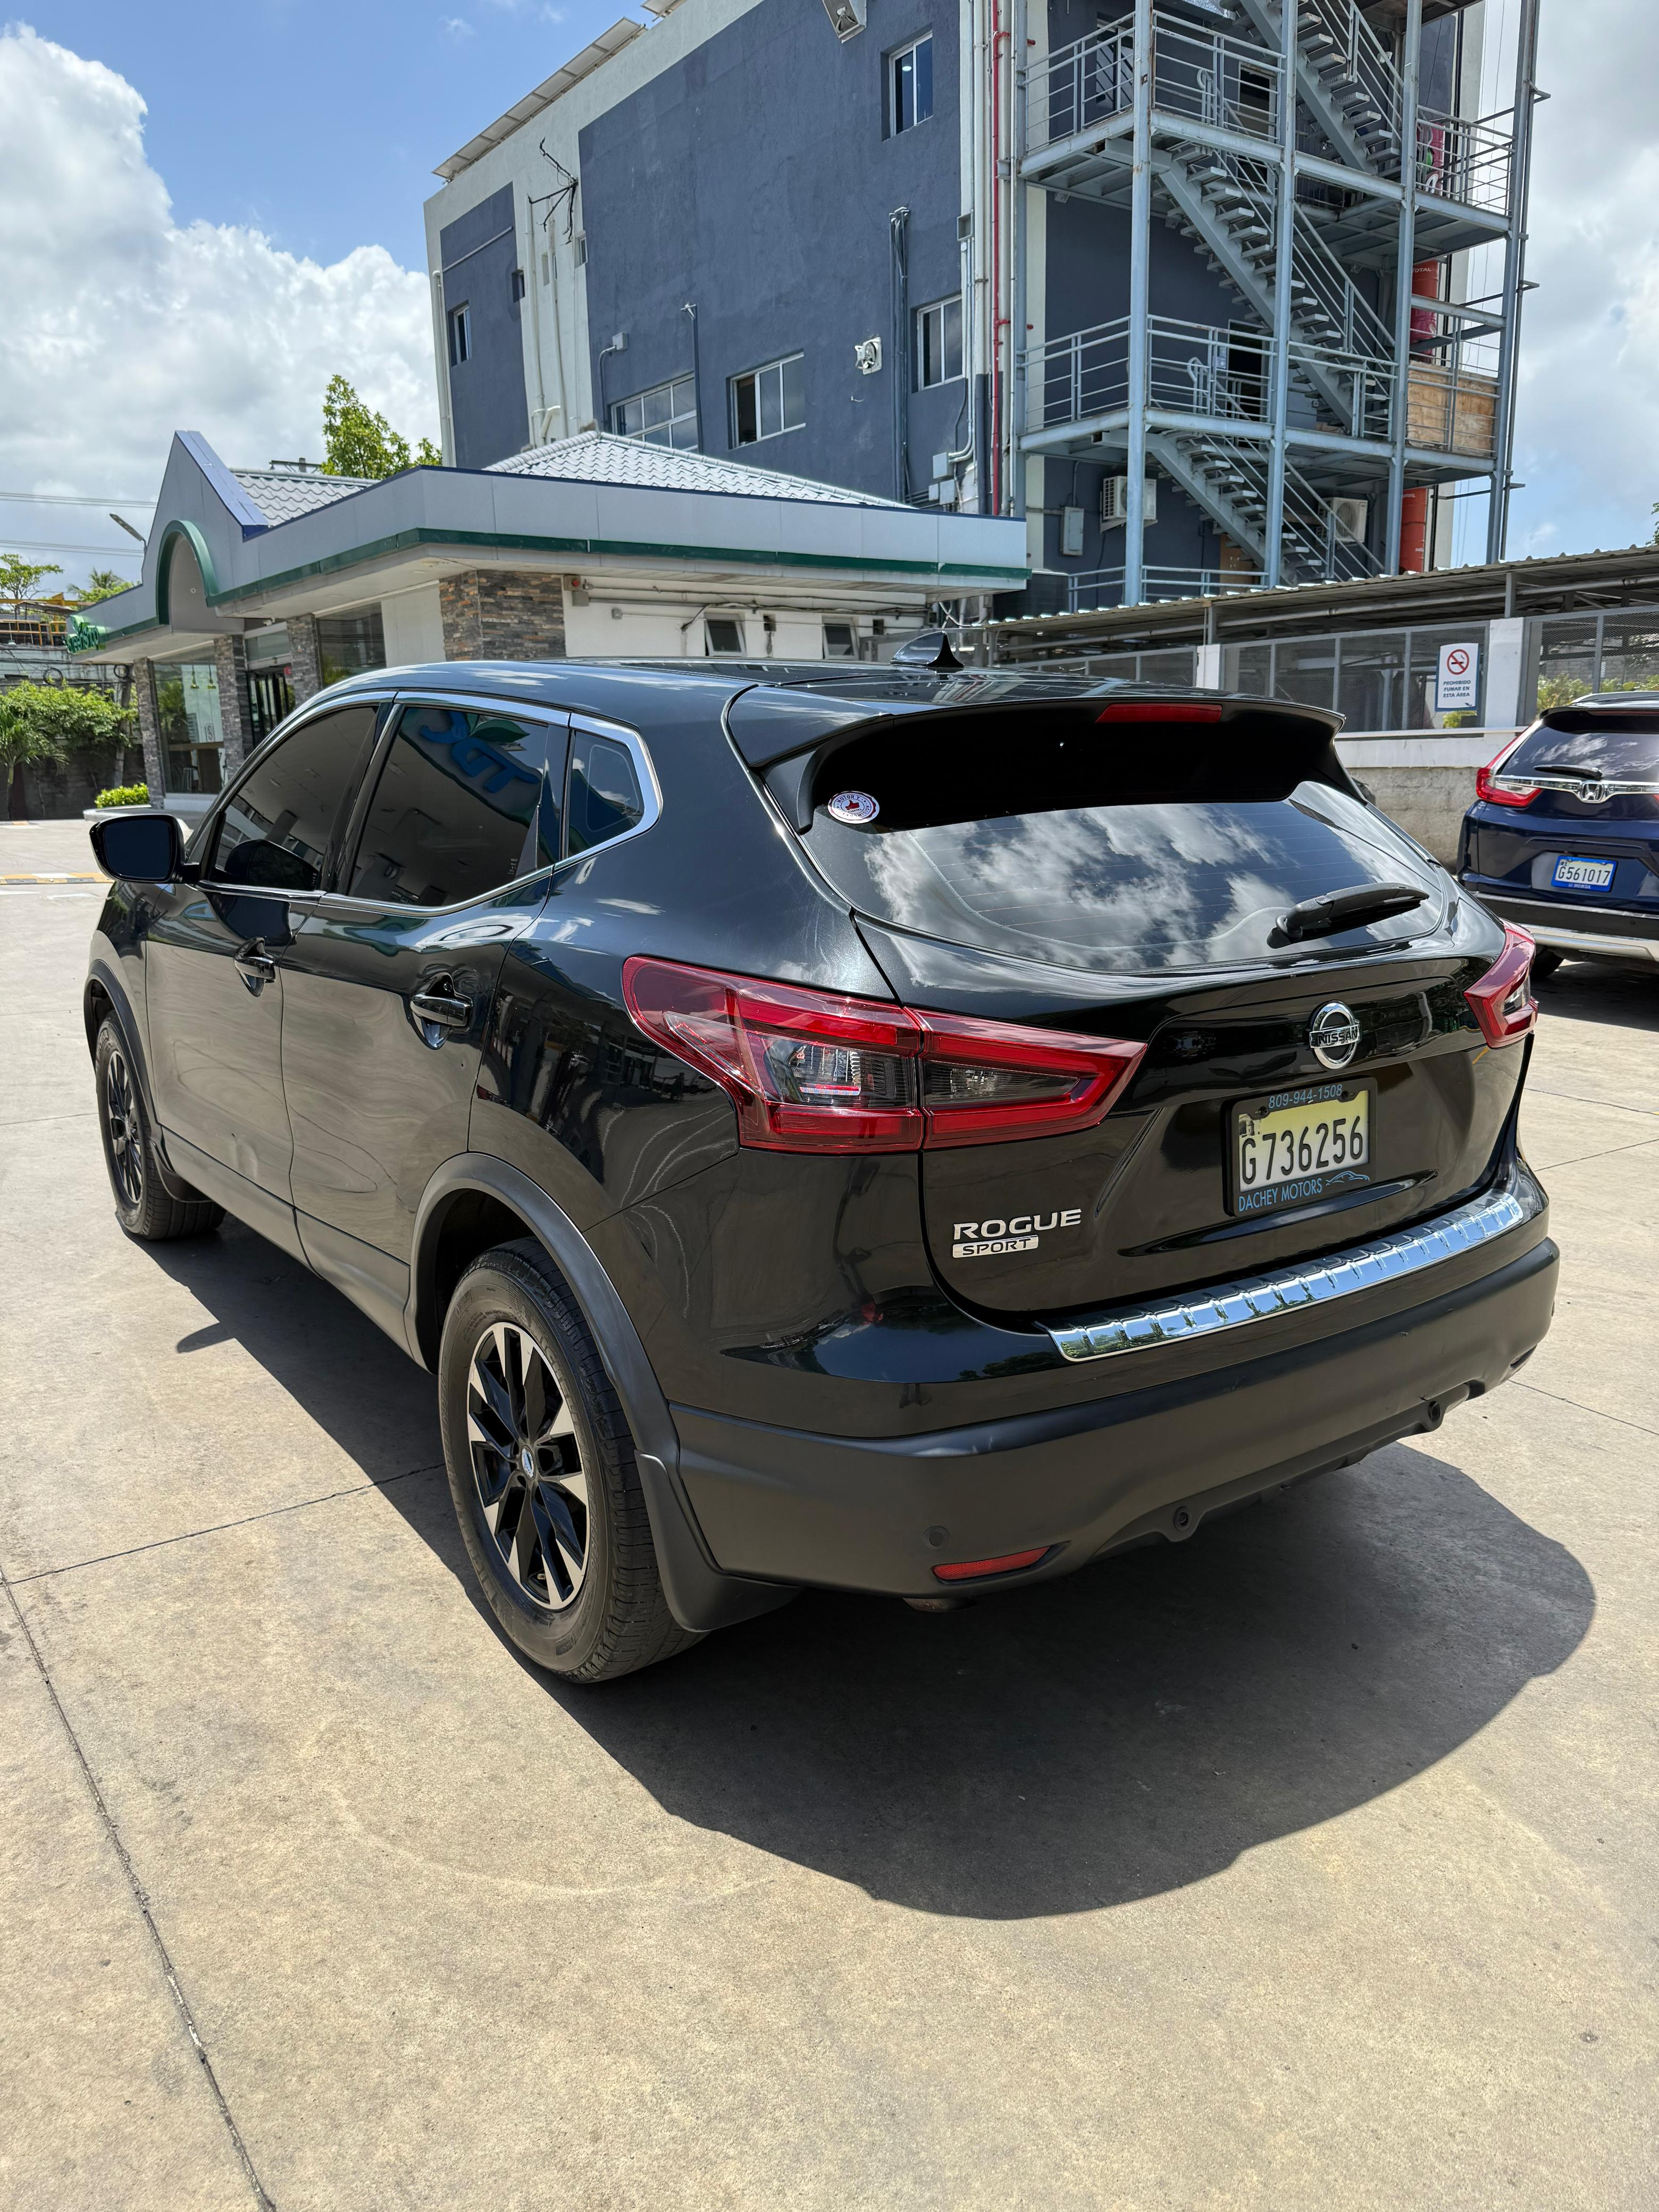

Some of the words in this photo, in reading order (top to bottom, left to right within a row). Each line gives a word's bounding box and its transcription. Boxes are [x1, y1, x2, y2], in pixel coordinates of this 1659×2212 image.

[836, 795, 854, 803] MOTOR
[1558, 866, 1611, 884] G561017
[1318, 1026, 1358, 1044] NISSAN
[1268, 1084, 1343, 1109] 809-944-1508
[1242, 1116, 1363, 1185] G736256
[1238, 1187, 1278, 1212] DACHEY
[1281, 1178, 1323, 1202] MOTORS
[953, 1208, 1082, 1240] ROGUE
[962, 1238, 1031, 1255] SPORT
